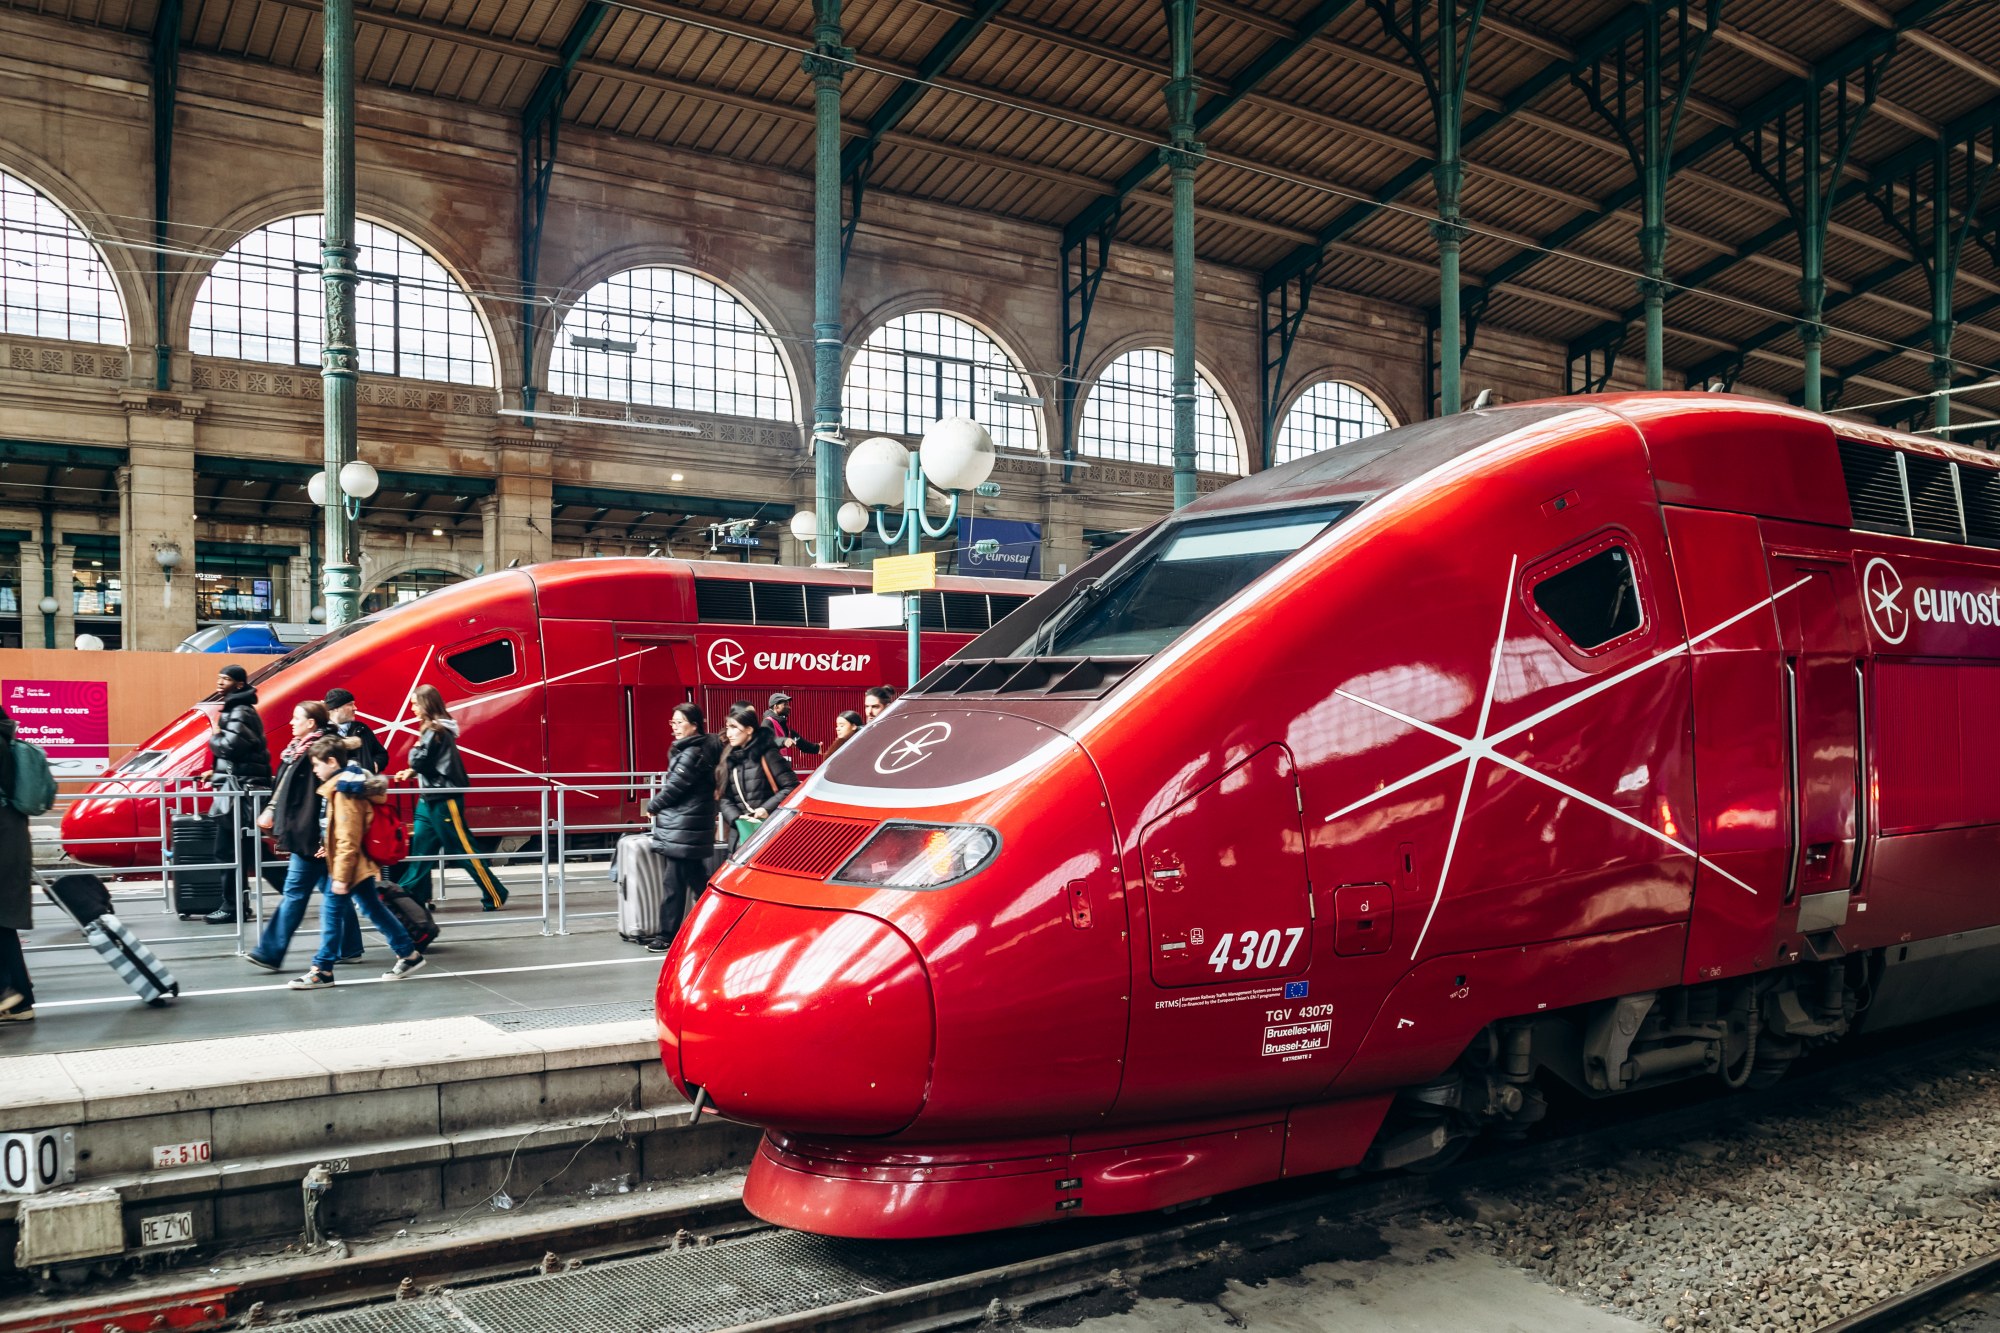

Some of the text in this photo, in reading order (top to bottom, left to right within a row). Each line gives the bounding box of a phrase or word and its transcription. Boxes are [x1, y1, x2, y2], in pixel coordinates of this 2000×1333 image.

[985, 553, 1030, 564] eurostar
[753, 650, 871, 672] eurostar
[10, 706, 48, 714] Travaux
[40, 726, 63, 734] Gare
[25, 736, 75, 744] modernise
[1208, 927, 1304, 973] 4307
[1155, 1000, 1179, 1009] ERTMS
[1266, 1004, 1334, 1022] TGV 43079
[1267, 1022, 1329, 1038] Bruxelles-Midi
[1265, 1038, 1321, 1053] Brussel-Zuid
[180, 1143, 210, 1164] 510
[143, 1216, 190, 1242] RE Z 10
